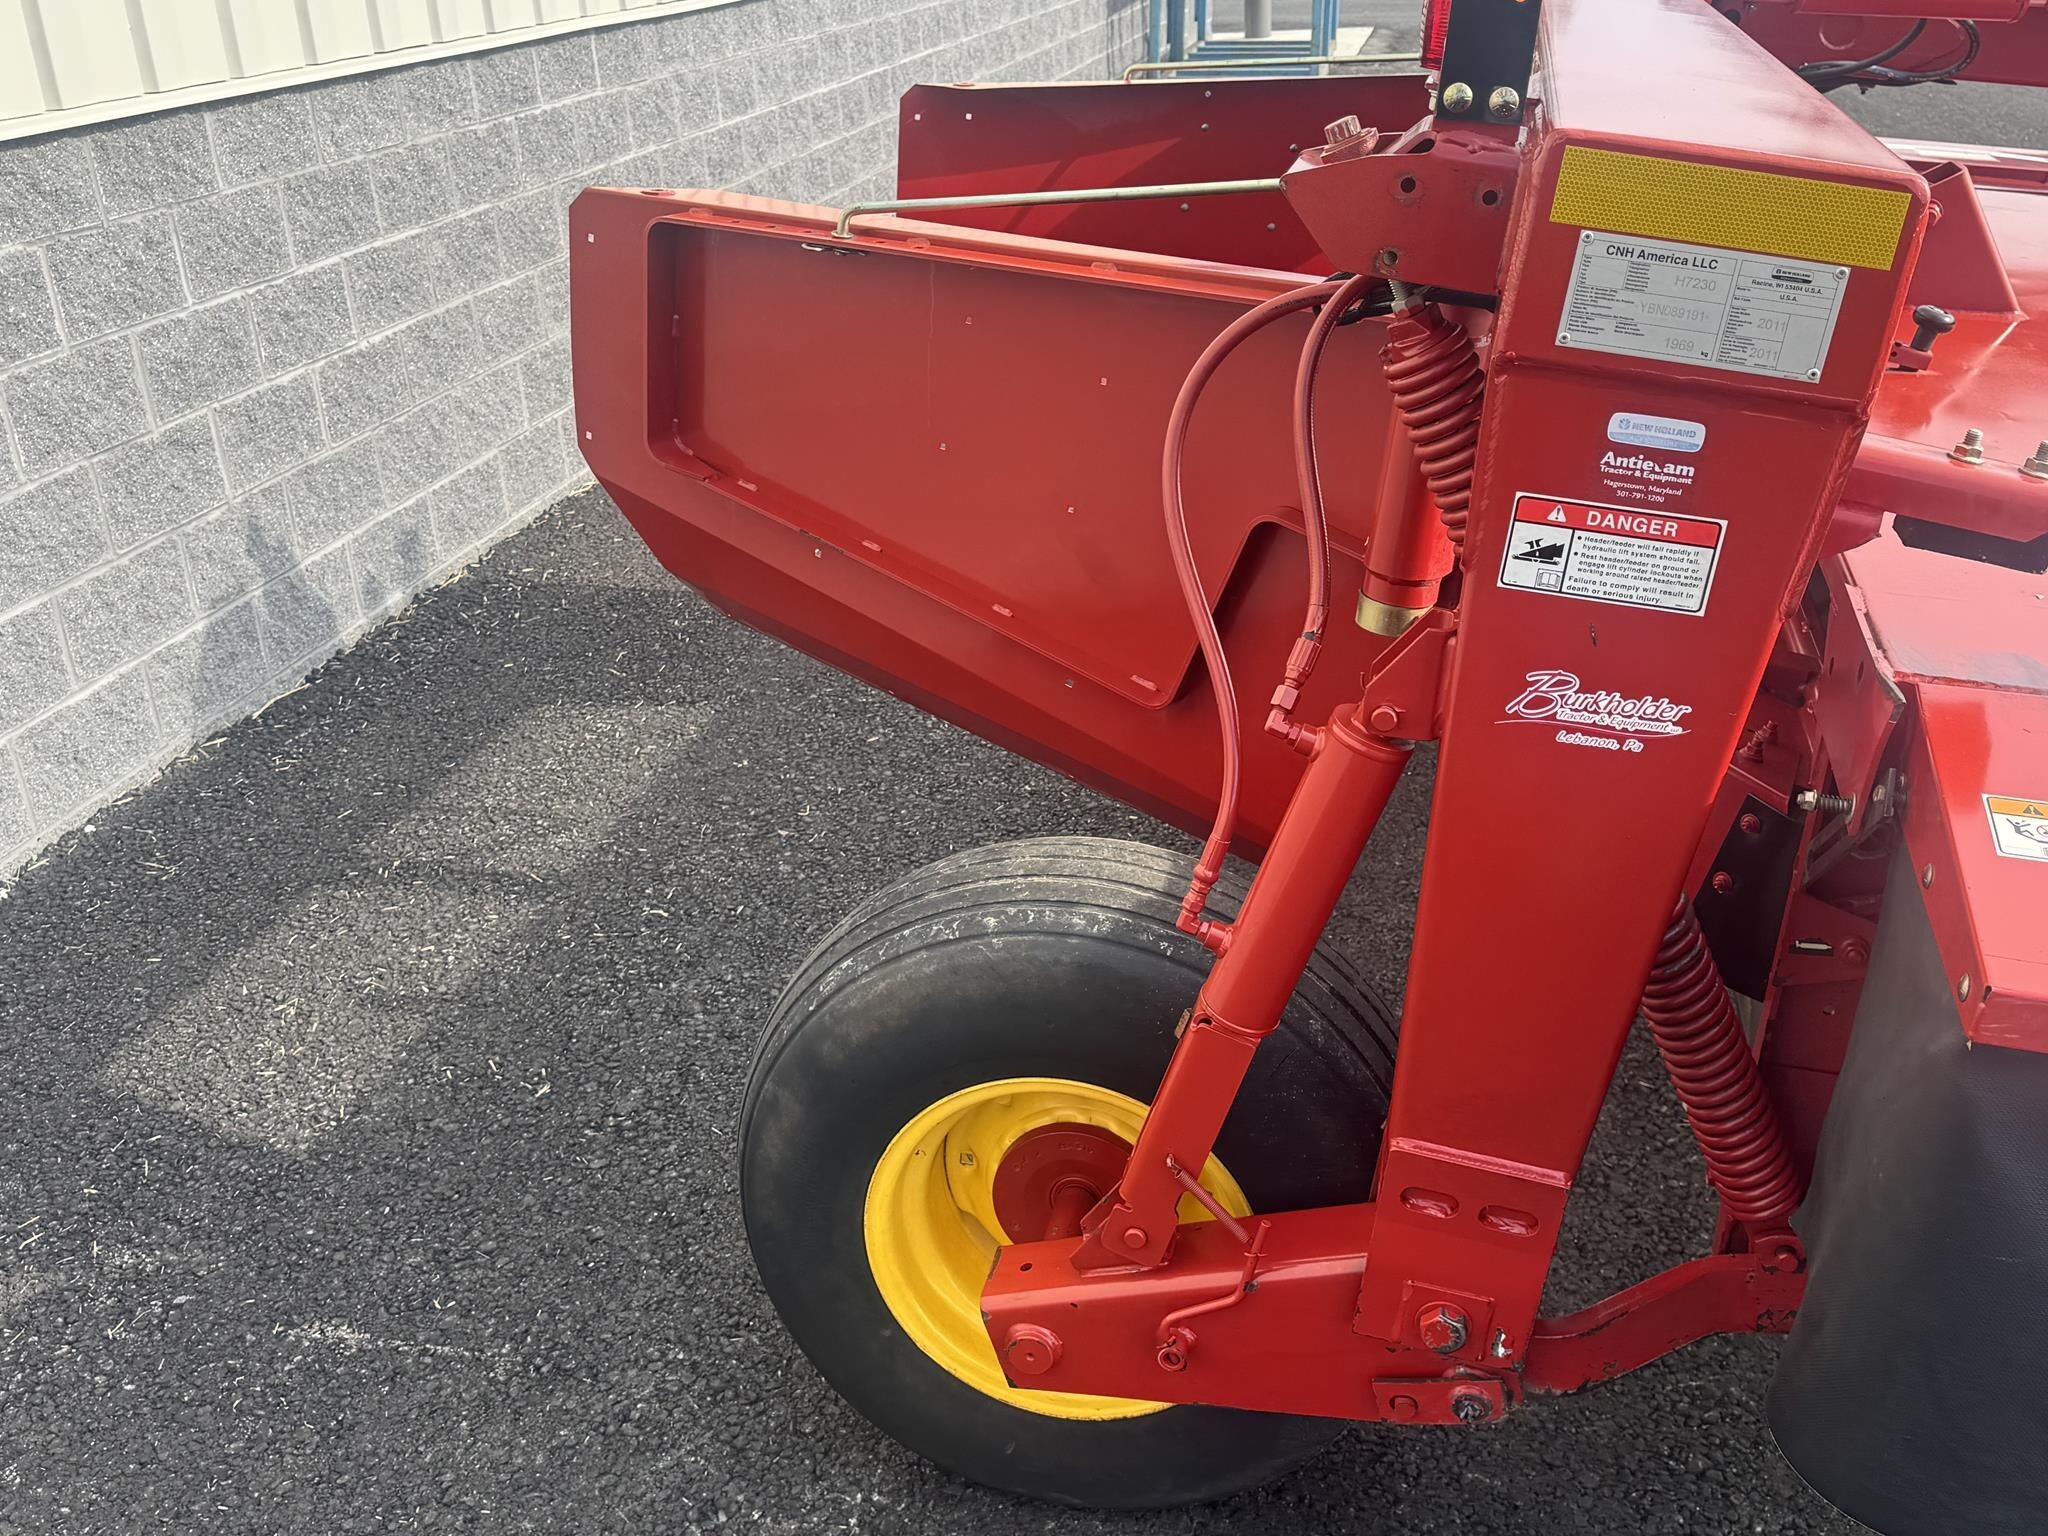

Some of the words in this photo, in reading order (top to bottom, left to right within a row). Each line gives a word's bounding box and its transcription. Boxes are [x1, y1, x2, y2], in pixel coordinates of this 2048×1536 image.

[1606, 244, 1635, 258] CNH
[1637, 249, 1688, 266] America
[1692, 256, 1719, 270] LLC
[1674, 274, 1717, 291] H7230
[1757, 318, 1786, 332] 2011
[1665, 337, 1695, 352] 1969
[1749, 346, 1778, 361] 2011
[1632, 422, 1653, 432] NEW
[1654, 425, 1697, 438] HOLLAND
[1600, 464, 1633, 476] Tractor
[1634, 469, 1641, 478] &
[1643, 471, 1693, 485] Equipment
[1603, 479, 1647, 491] Hagerstown,
[1648, 485, 1683, 496] Maryland
[1615, 490, 1665, 502] 301-791-1200
[1587, 510, 1678, 538] DANGER
[1582, 543, 1617, 554] hydraulic
[1619, 548, 1629, 556] lift
[1630, 550, 1657, 559] system
[1659, 554, 1685, 563] should
[1584, 535, 1635, 549] Header/feeder
[1637, 541, 1651, 550] will
[1665, 547, 1691, 557] rapidly
[1578, 560, 1605, 571] engage
[1618, 565, 1648, 575] cylinder
[1650, 569, 1681, 579] lockouts
[1683, 573, 1703, 582] when
[1580, 552, 1598, 560] Rest
[1599, 554, 1649, 568] header/feeder
[1662, 564, 1690, 574] ground
[1577, 567, 1604, 577] working
[1605, 571, 1629, 580] around
[1630, 574, 1652, 583] raised
[1566, 584, 1590, 594] death
[1602, 590, 1634, 600] serious
[1635, 593, 1663, 604] injury.
[1568, 575, 1597, 586] Failure
[1599, 579, 1608, 587] to
[1609, 582, 1640, 593] comply
[1642, 584, 1658, 594] will
[1659, 588, 1684, 598] result
[1685, 591, 1694, 599] in
[1505, 670, 1692, 721] Burkholder
[1556, 709, 1599, 724] Tractor
[1599, 713, 1608, 725] &
[1609, 715, 1670, 733] Equipment
[1555, 730, 1620, 750] Lebanon,
[1622, 738, 1644, 752] Pa
